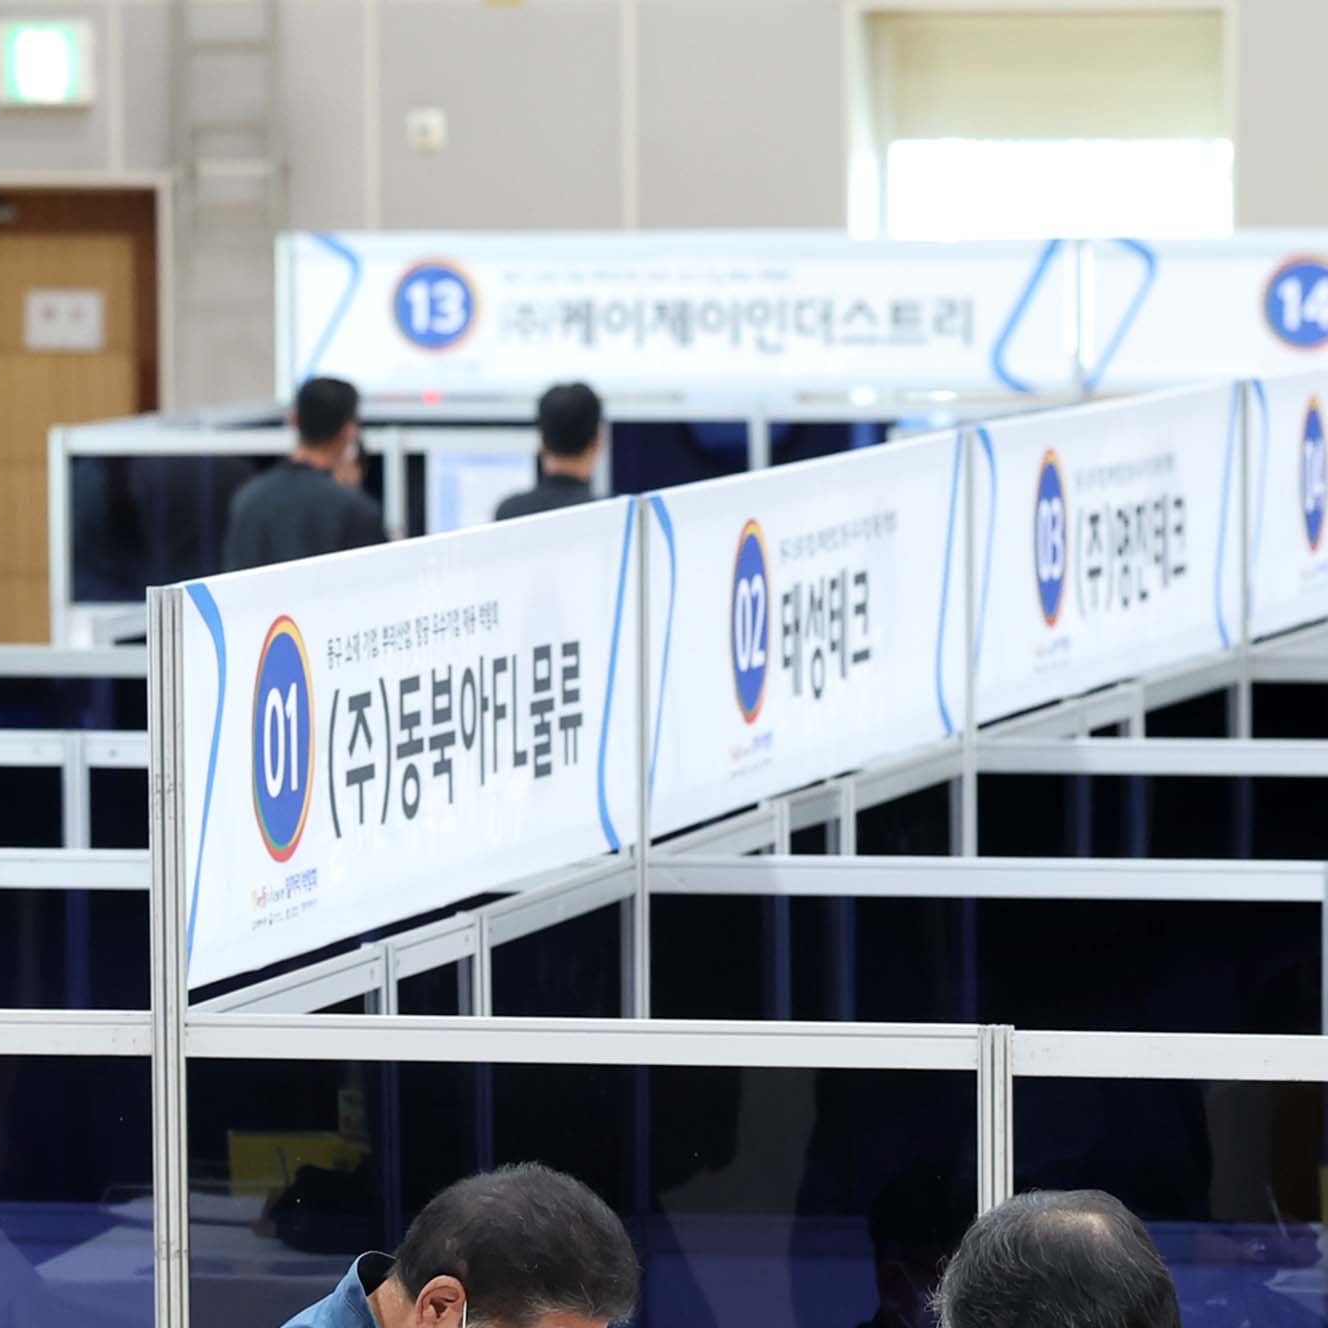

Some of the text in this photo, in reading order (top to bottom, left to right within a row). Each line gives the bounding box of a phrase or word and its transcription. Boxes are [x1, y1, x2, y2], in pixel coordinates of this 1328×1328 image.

[405, 280, 468, 330] 13
[1036, 498, 1064, 583] 03
[735, 573, 767, 673] 02
[263, 682, 298, 798] 01
